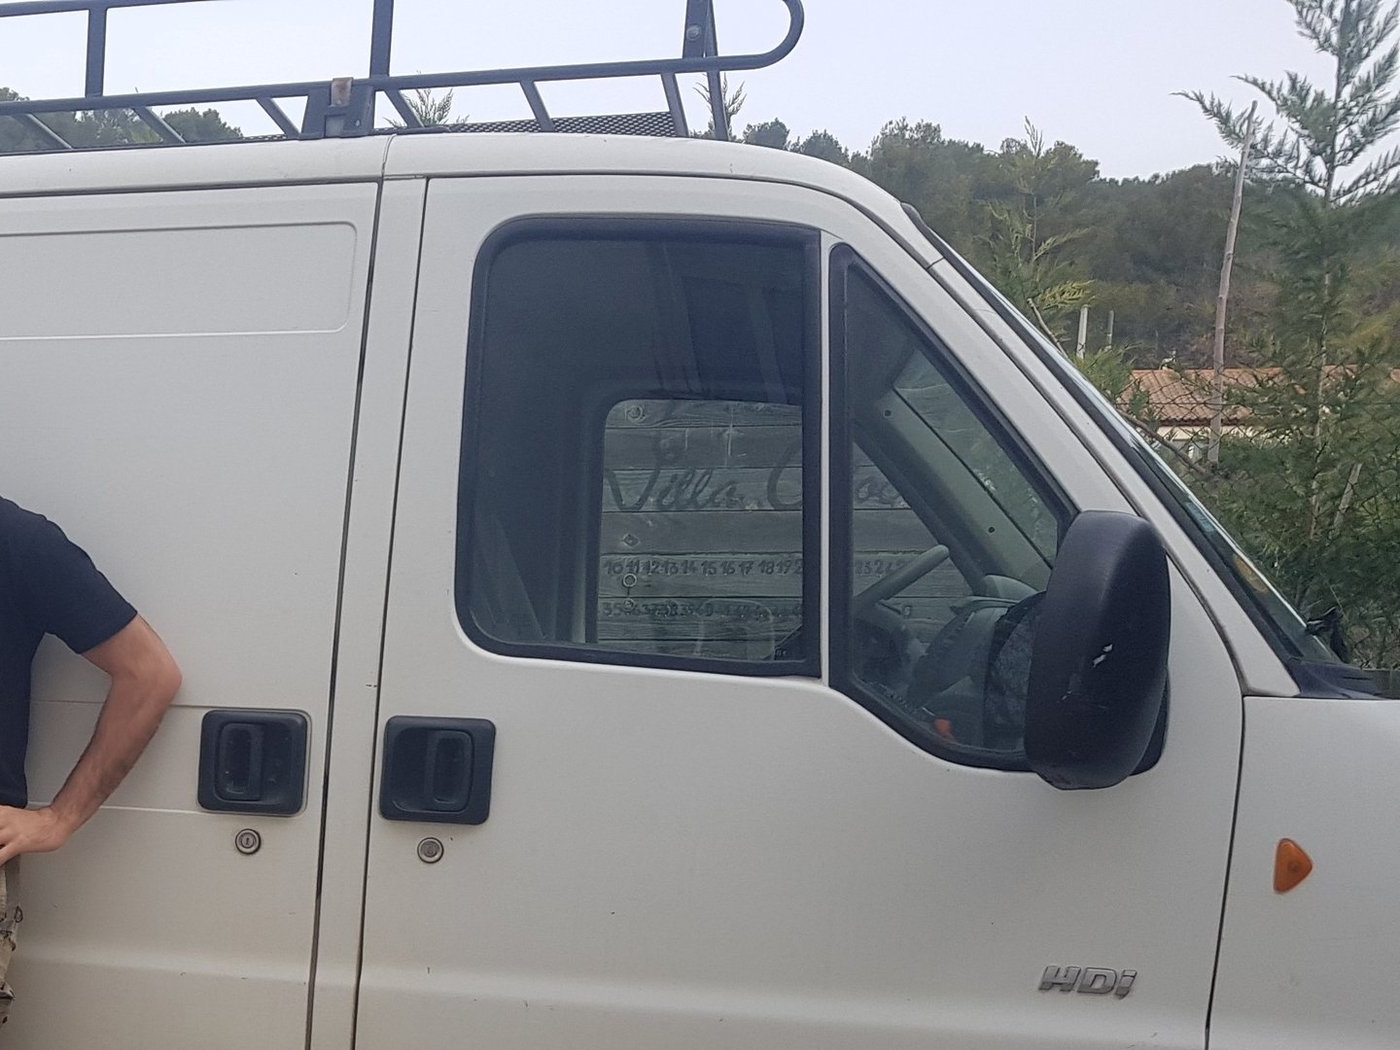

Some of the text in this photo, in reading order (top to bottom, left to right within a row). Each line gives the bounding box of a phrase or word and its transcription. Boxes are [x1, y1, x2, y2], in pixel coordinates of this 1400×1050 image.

[604, 560, 623, 575] 10
[701, 560, 717, 575] 15
[758, 560, 774, 575] 18
[776, 560, 792, 575] 19
